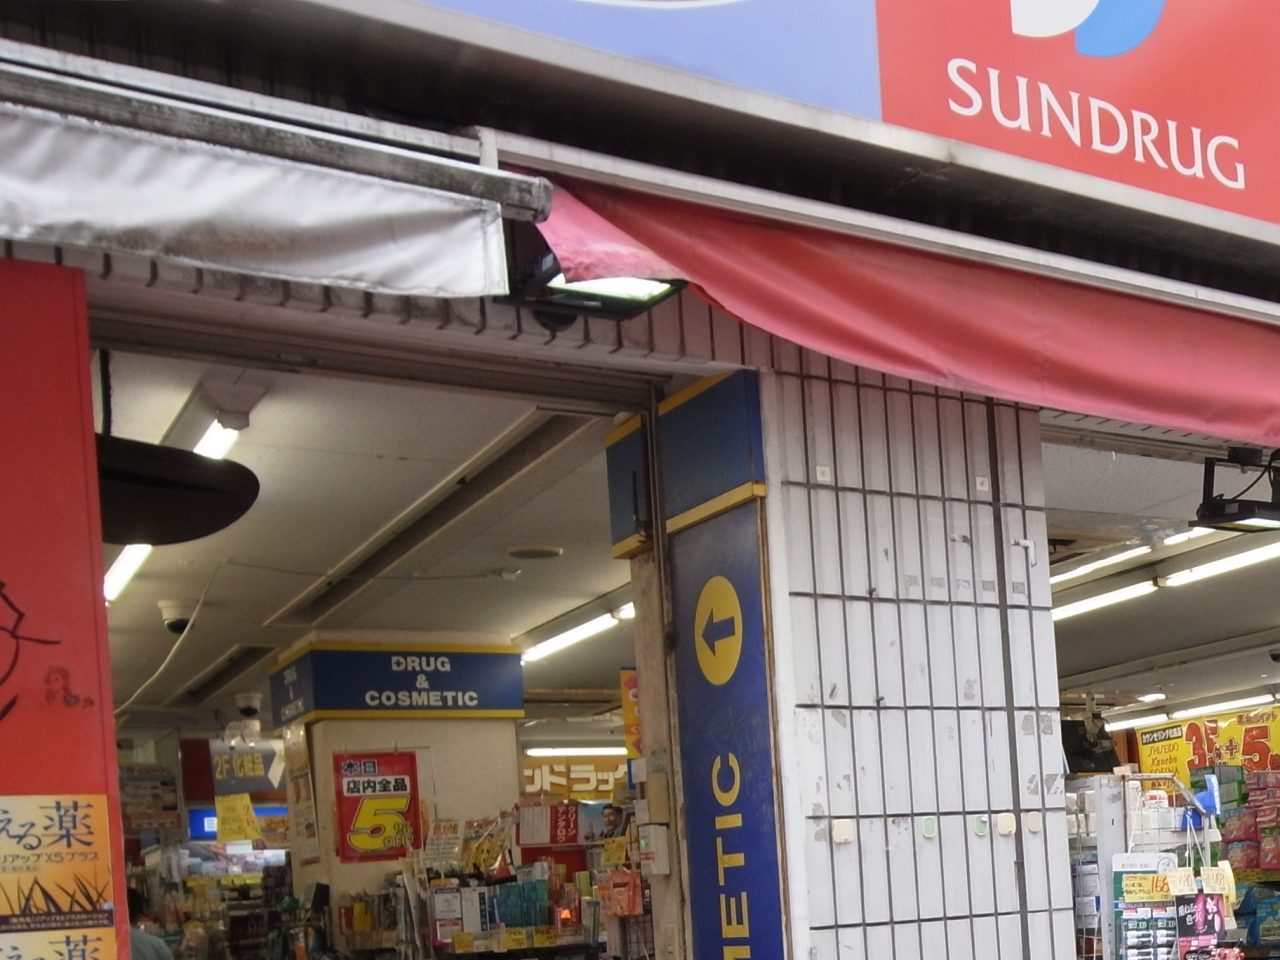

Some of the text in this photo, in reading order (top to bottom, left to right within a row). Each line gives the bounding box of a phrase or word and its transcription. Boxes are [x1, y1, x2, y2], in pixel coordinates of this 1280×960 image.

[946, 56, 1247, 190] SUNDRUG
[391, 656, 451, 672] DRUG
[415, 674, 430, 688] &
[365, 690, 478, 706] COSMETIC
[214, 754, 229, 779] 2F
[342, 760, 377, 775] 本日
[347, 778, 407, 793] 店内全品
